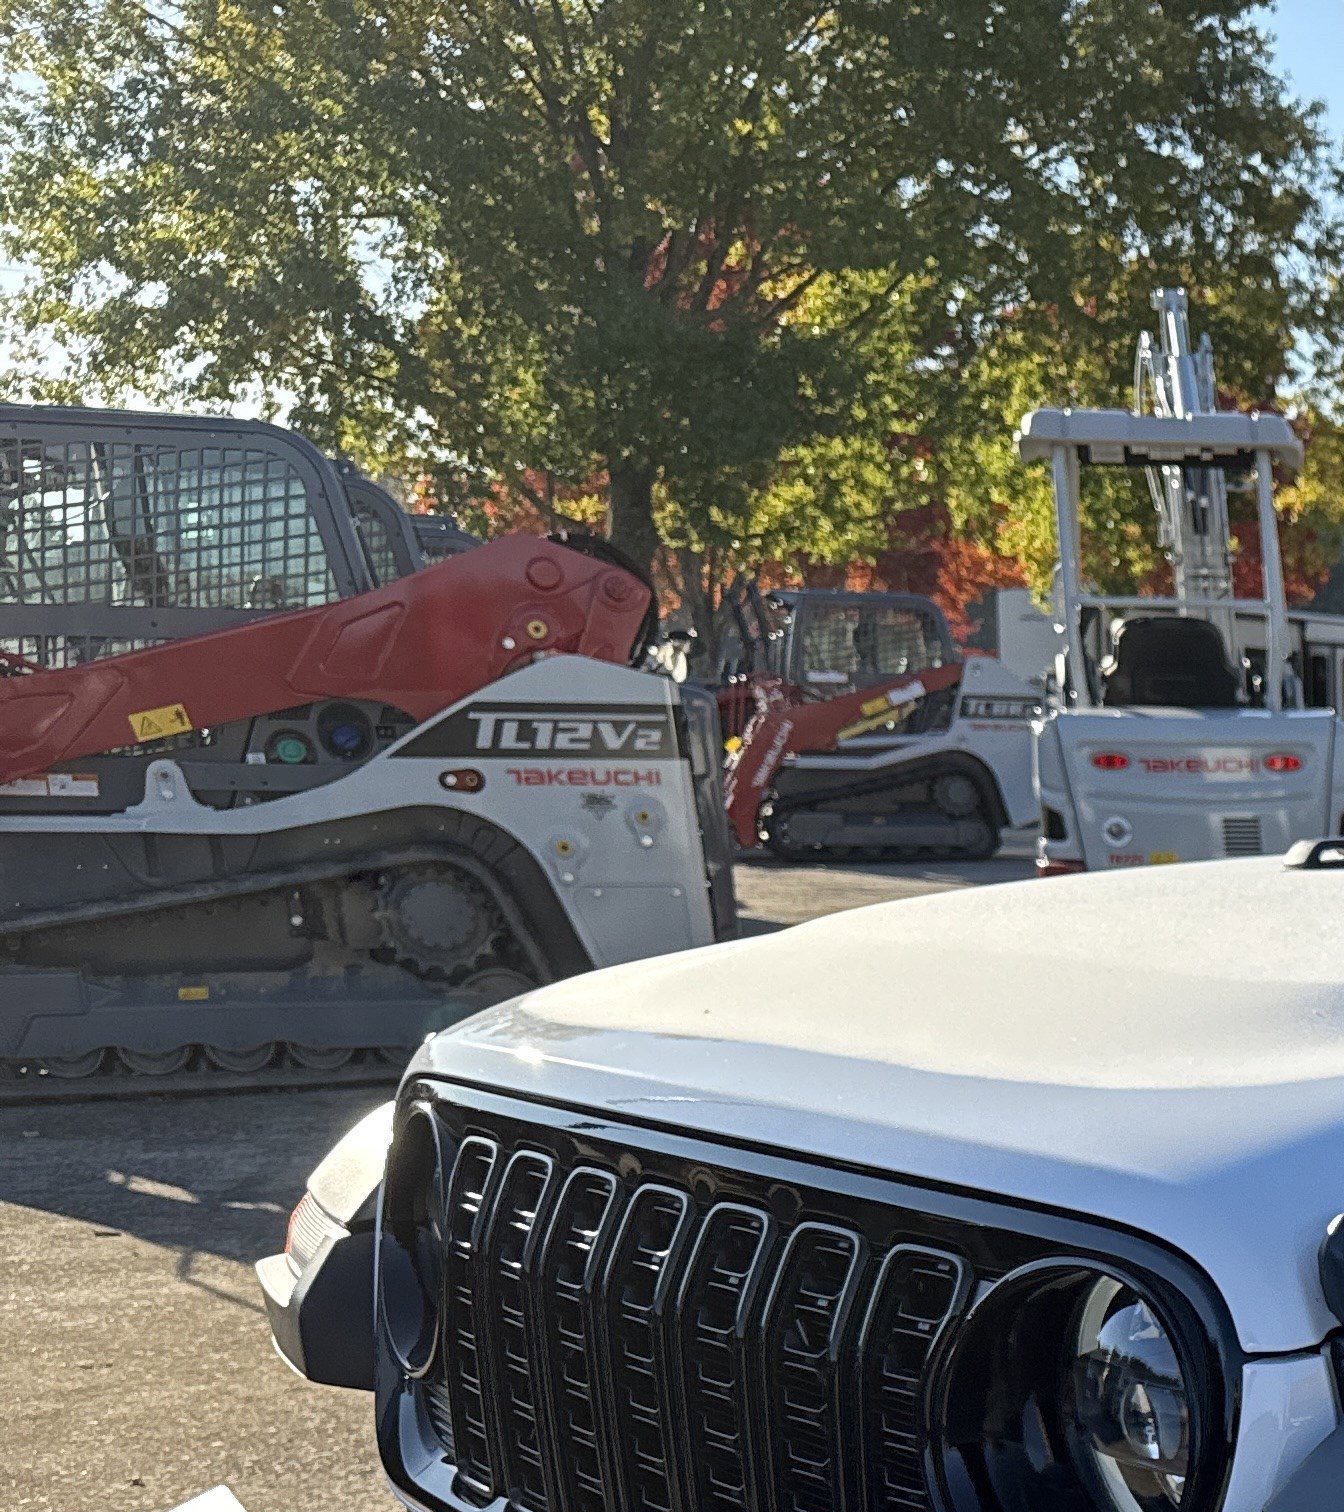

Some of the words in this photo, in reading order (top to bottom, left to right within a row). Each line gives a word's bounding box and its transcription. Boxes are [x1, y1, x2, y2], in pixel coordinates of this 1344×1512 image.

[468, 711, 667, 750] TL12V2
[1139, 758, 1262, 774] TAKEUCHI
[506, 767, 662, 786] TAKEUCHI
